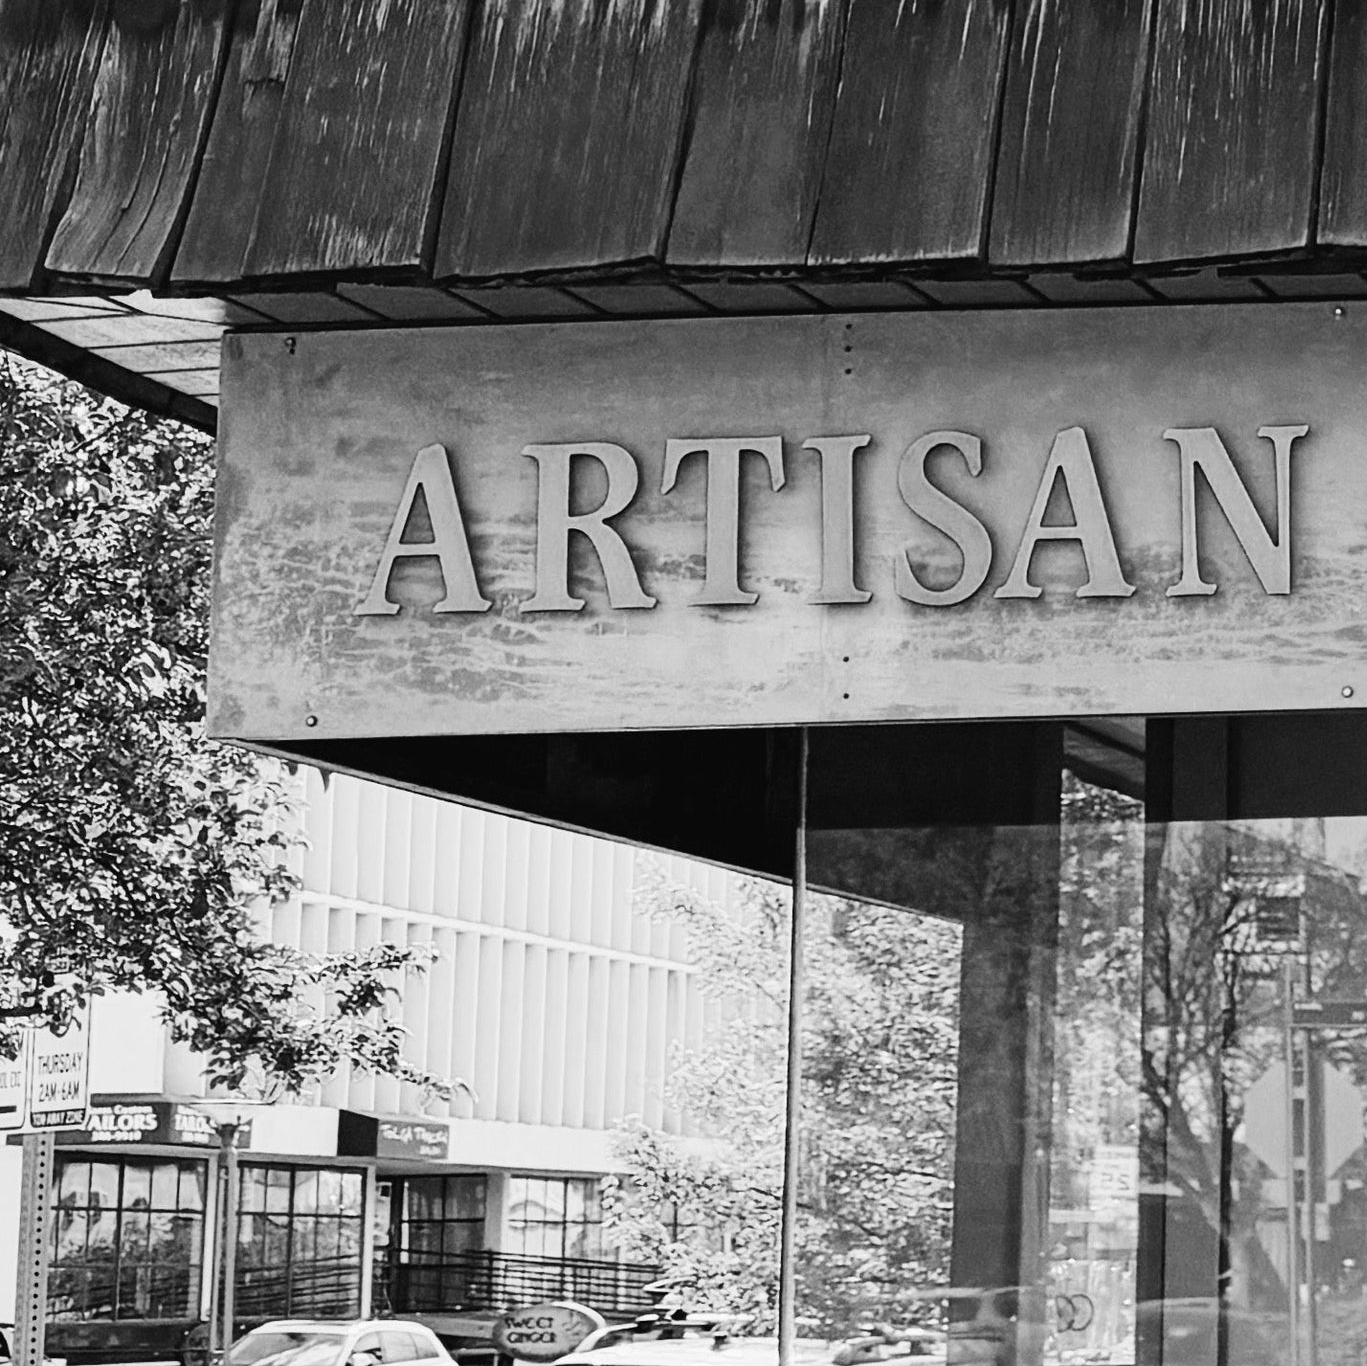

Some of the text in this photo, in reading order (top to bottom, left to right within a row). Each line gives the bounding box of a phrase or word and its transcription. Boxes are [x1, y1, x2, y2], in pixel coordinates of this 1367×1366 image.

[356, 422, 1311, 617] ARTISAN
[38, 1052, 83, 1075] THURSDAY
[86, 1113, 158, 1131] AILORS
